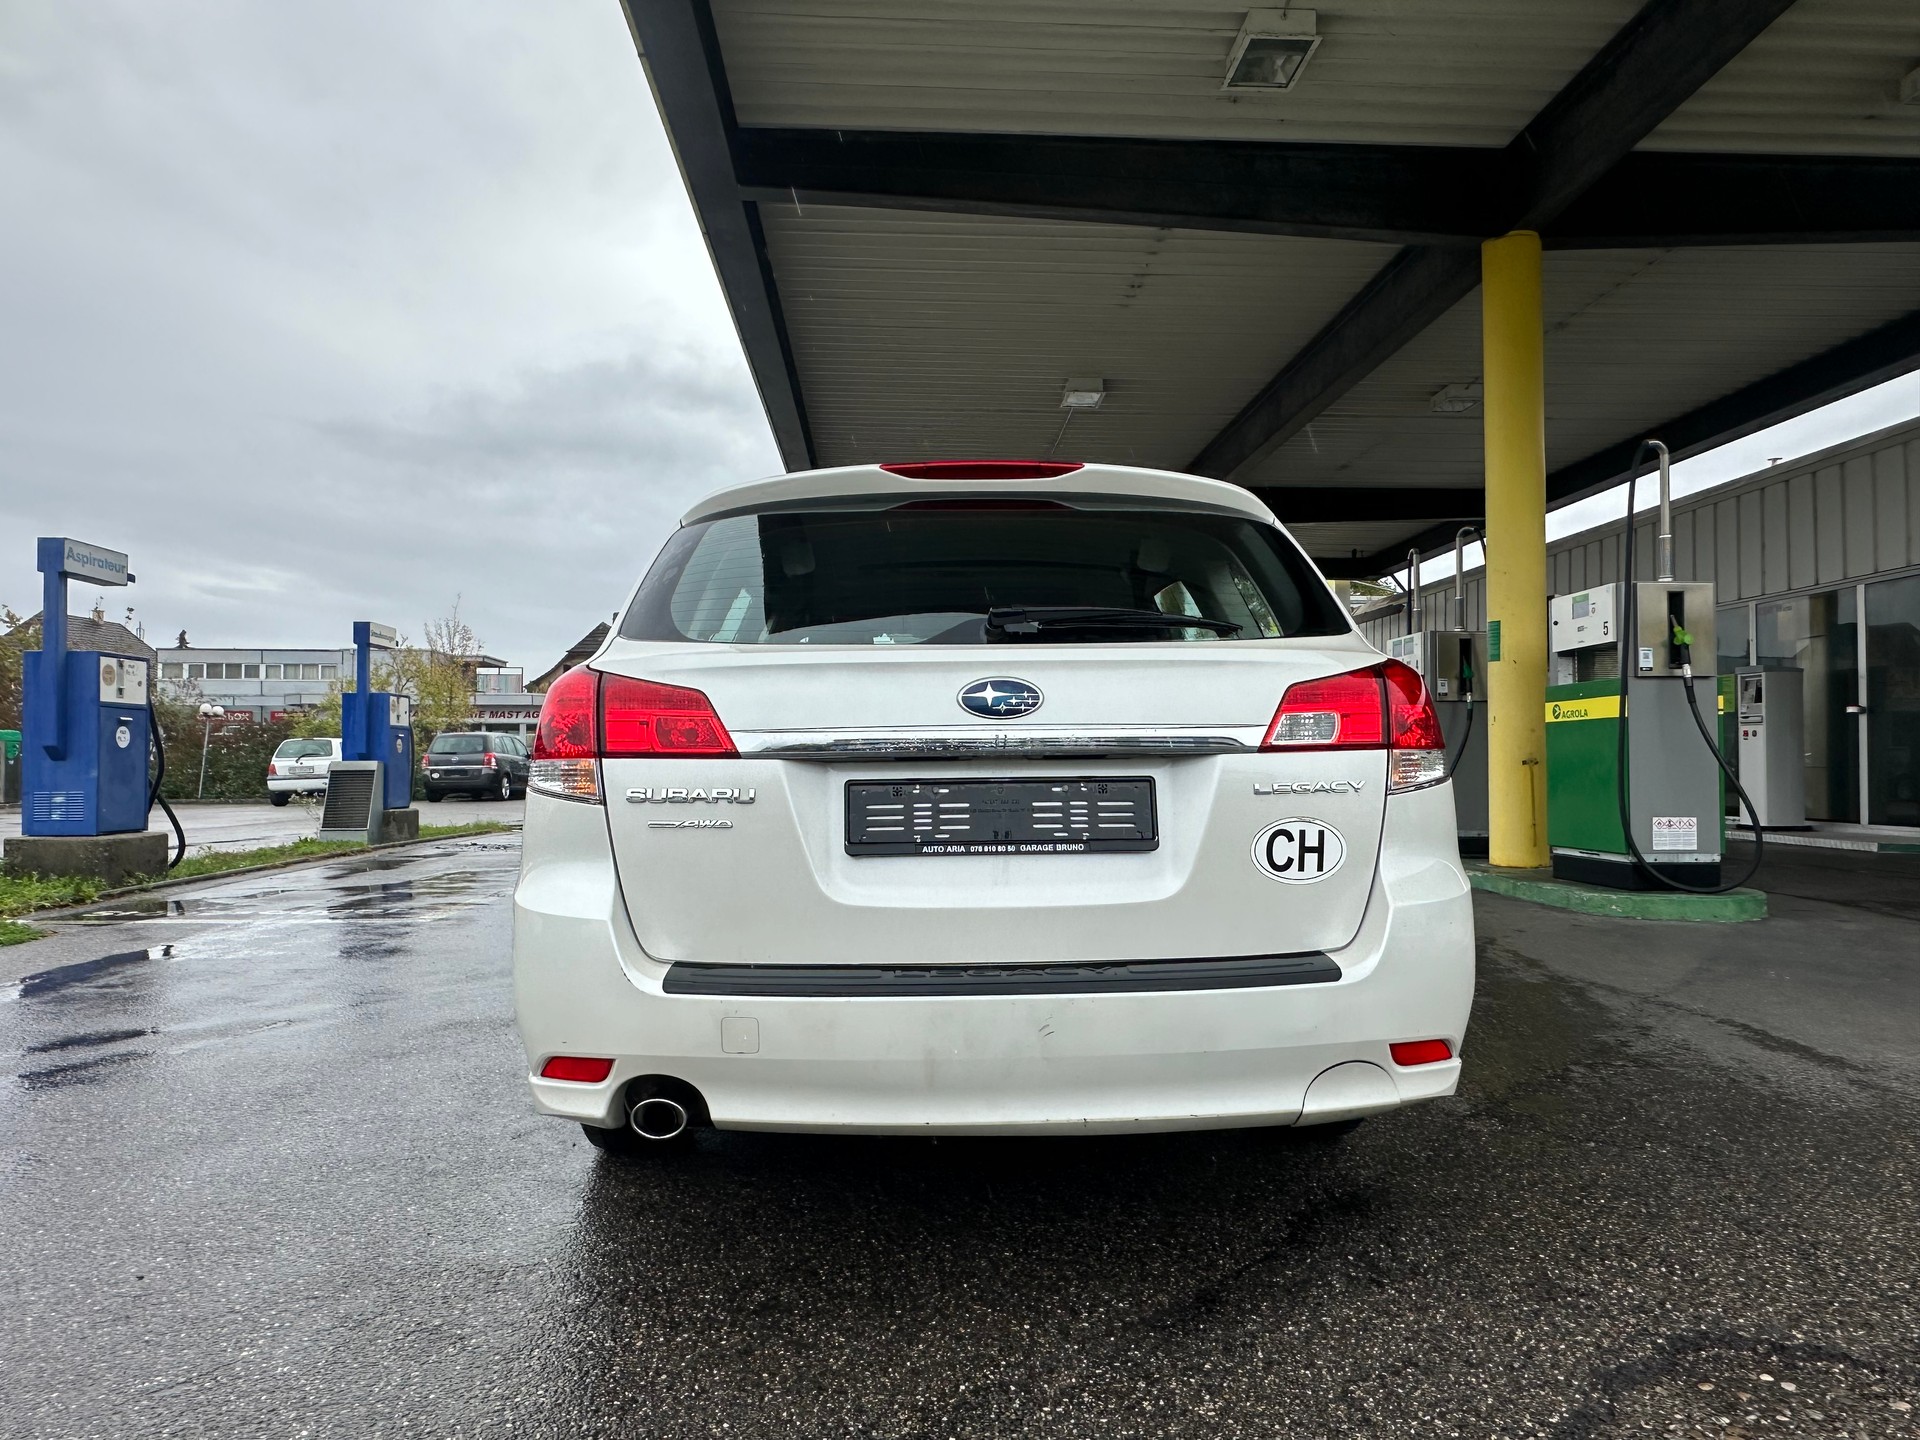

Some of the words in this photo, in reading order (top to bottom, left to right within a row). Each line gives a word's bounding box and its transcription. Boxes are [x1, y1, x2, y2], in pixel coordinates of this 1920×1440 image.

[66, 546, 126, 574] Aspirateur
[1603, 621, 1609, 636] 5
[488, 710, 521, 719] MAST
[523, 710, 540, 719] AG
[1562, 709, 1588, 719] AGROLA
[1253, 780, 1366, 795] LEGACY
[626, 788, 756, 804] SUBARU
[922, 845, 945, 853] AUTO
[946, 845, 966, 853] ARIA
[1020, 844, 1054, 852] GARAGE
[1056, 843, 1084, 851] BRUNO
[1266, 829, 1325, 872] CH
